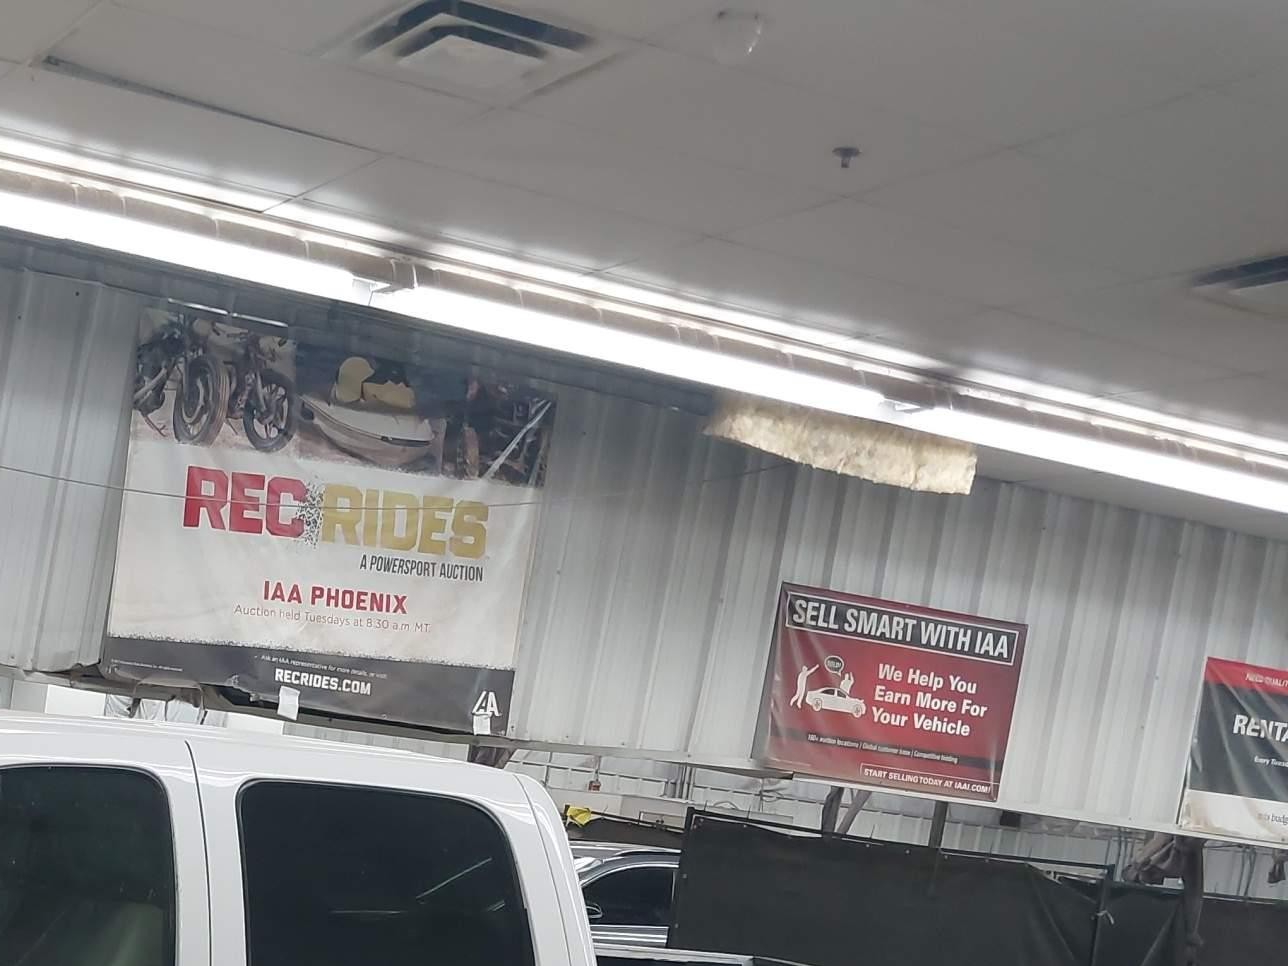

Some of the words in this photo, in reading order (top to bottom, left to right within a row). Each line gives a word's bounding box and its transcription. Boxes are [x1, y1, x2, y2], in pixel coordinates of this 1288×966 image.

[183, 465, 308, 538] REC
[321, 484, 489, 560] RIDES
[360, 554, 368, 570] A
[370, 555, 438, 577] POWERSPORT
[440, 563, 484, 582] AUCTION
[263, 580, 303, 604] IAA
[310, 586, 408, 614] PHOENIX
[233, 604, 276, 617] Auction
[279, 607, 301, 621] held
[304, 611, 351, 627] Tuesdays
[353, 618, 363, 627] at
[793, 599, 839, 630] SELL
[844, 608, 917, 642] SMART
[920, 621, 972, 652] WITH
[975, 630, 1009, 659] IAA
[274, 668, 372, 695] RECRIDES.COM
[878, 663, 903, 682] We
[907, 668, 944, 692] Help
[949, 675, 977, 694] You
[874, 685, 911, 706] Earn
[915, 692, 957, 713] More
[961, 699, 988, 717] For
[871, 706, 909, 727] Your
[913, 713, 971, 737] Vehicle
[864, 768, 888, 779] START
[888, 772, 919, 783] SELLING
[919, 776, 943, 787] TODAY
[943, 780, 954, 788] AT
